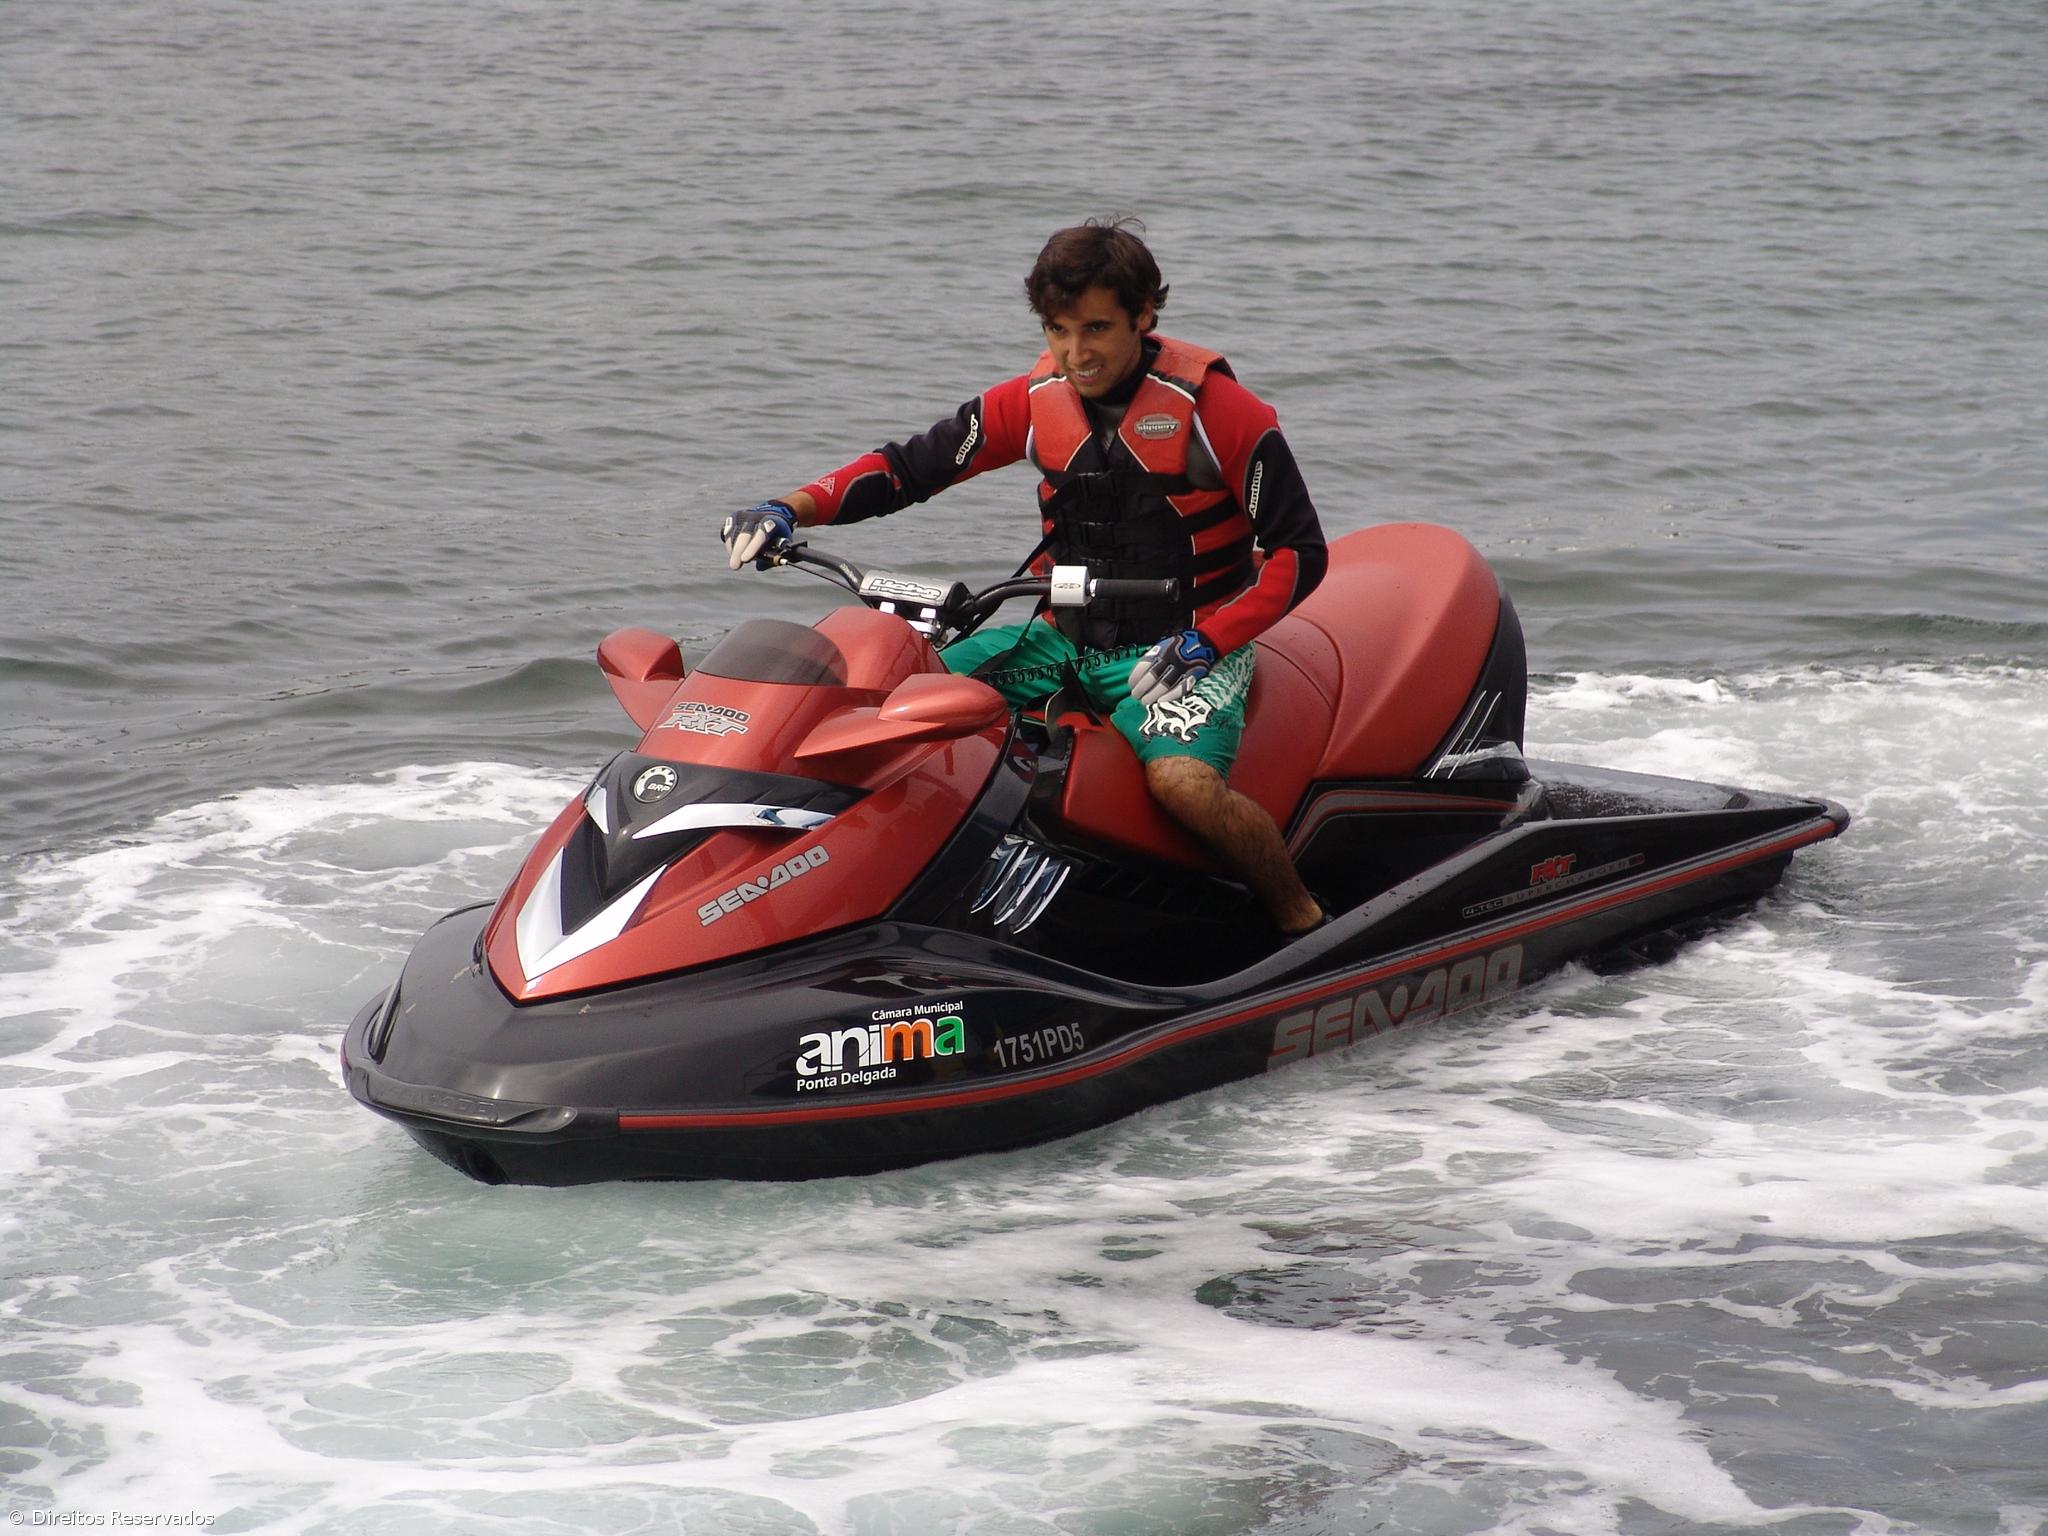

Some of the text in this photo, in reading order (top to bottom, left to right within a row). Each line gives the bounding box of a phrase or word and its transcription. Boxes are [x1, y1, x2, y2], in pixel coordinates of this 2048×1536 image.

[646, 782, 671, 793] BRP
[871, 1000, 964, 1021] Câmara Municipal
[795, 1015, 966, 1077] anima
[993, 1022, 1085, 1069] 1751PD5
[796, 1066, 897, 1092] Ponta Delgada
